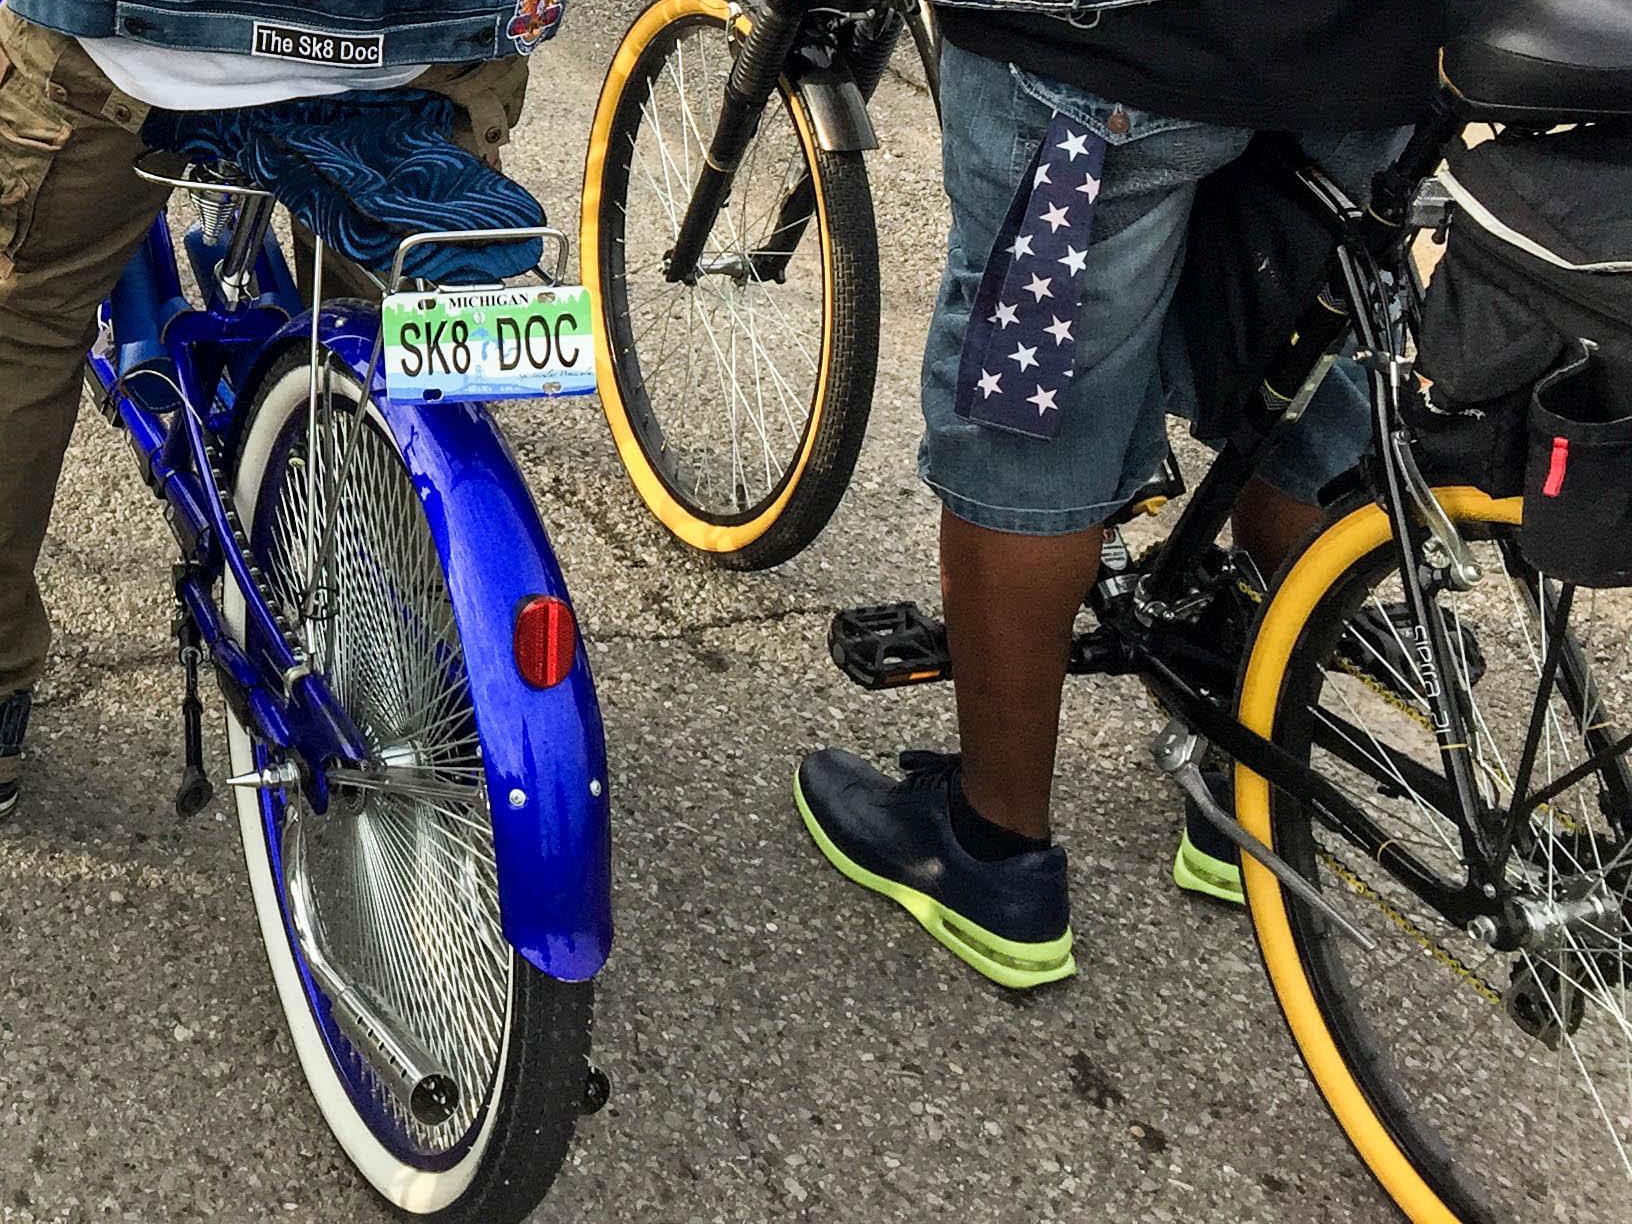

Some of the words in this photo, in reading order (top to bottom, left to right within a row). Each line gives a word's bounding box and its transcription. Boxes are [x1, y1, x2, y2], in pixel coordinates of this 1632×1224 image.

[258, 28, 294, 53] The
[298, 35, 334, 59] Sk8
[340, 40, 378, 61] Doc
[449, 292, 529, 309] MICHIGAN
[400, 319, 471, 377] SK8
[496, 313, 580, 371] DOC
